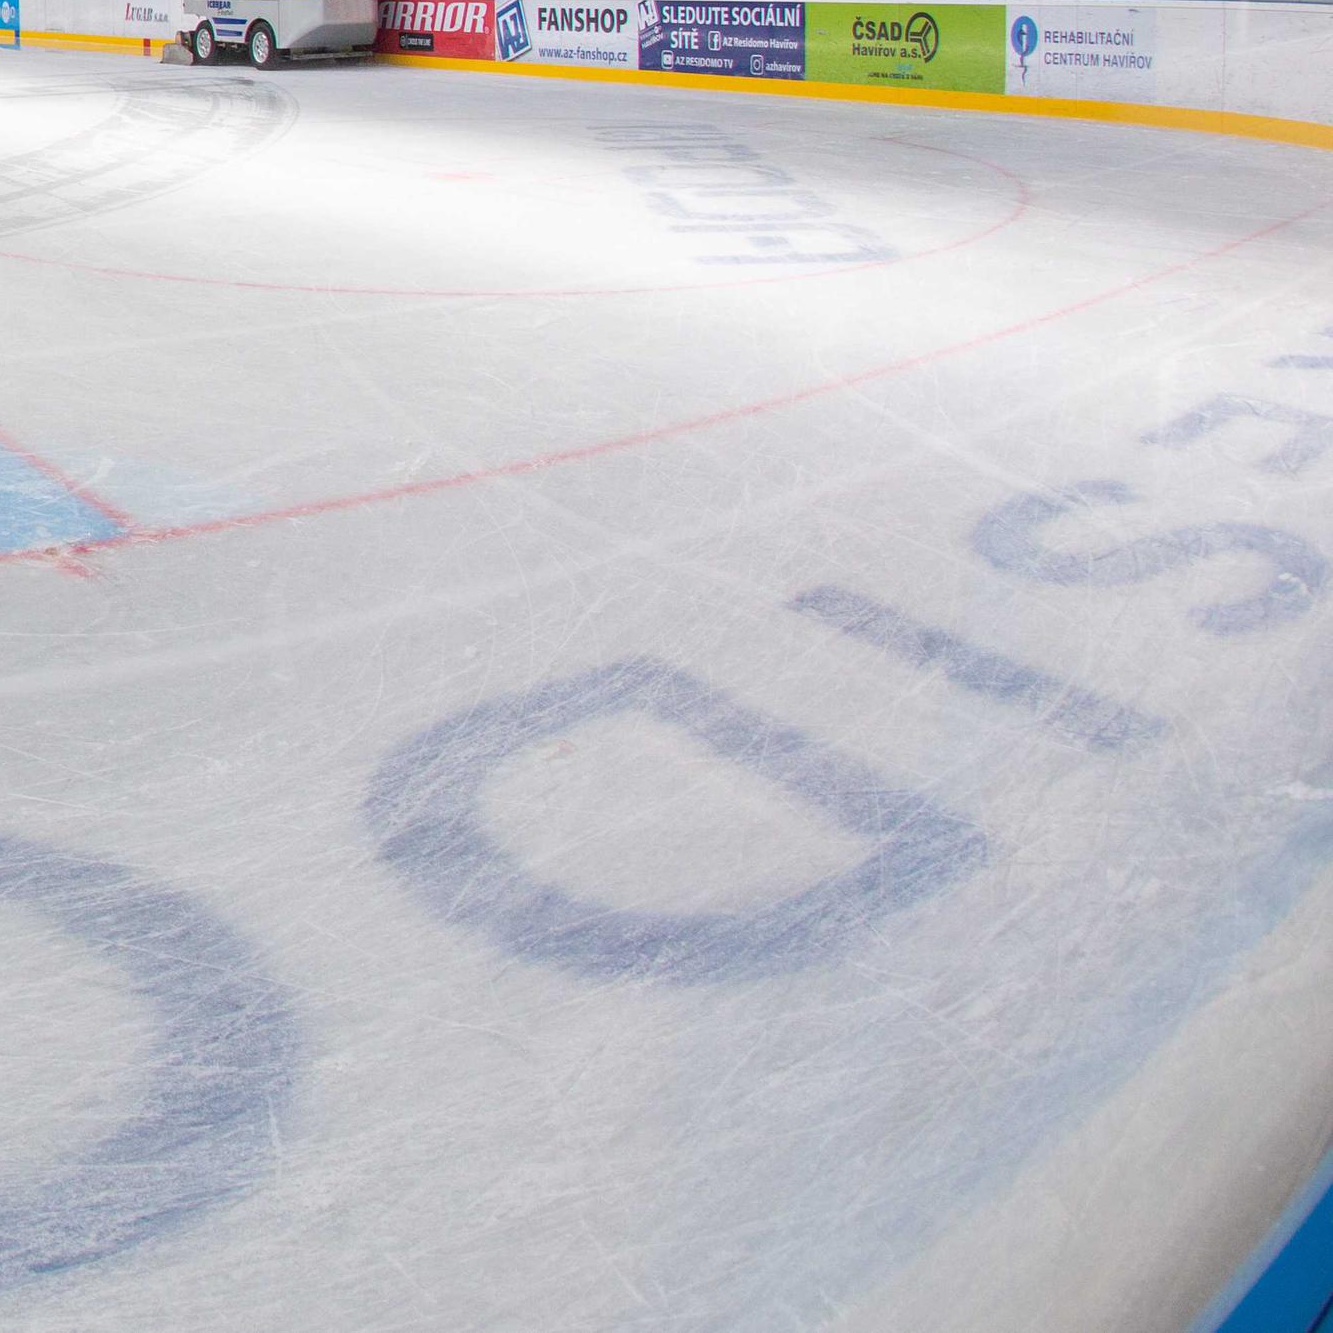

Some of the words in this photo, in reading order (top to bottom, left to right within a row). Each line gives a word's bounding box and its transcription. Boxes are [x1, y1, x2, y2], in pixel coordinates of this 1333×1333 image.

[125, 2, 153, 23] LUGAB
[207, 0, 231, 9] ICEBEAR
[379, 1, 487, 34] ARRIOR
[538, 7, 628, 34] FANSHOP
[662, 5, 730, 26] SLEDUJTE
[732, 3, 801, 27] SOCIÁLNÍ
[670, 26, 699, 50] SÍTĚ
[852, 16, 902, 41] ČSAD
[1044, 29, 1134, 47] REHABILITAČNÍ
[722, 37, 733, 47] AZ
[734, 37, 769, 49] Residomo
[852, 43, 896, 57] Havířov
[900, 48, 921, 58] a.s.
[538, 46, 627, 65] www.az-fanshop.cz
[675, 57, 685, 67] AZ
[686, 57, 722, 68] RESIDOMO
[724, 58, 733, 69] TV
[1044, 53, 1100, 67] CENTRUM
[1102, 52, 1153, 70] HAVÍŘOV
